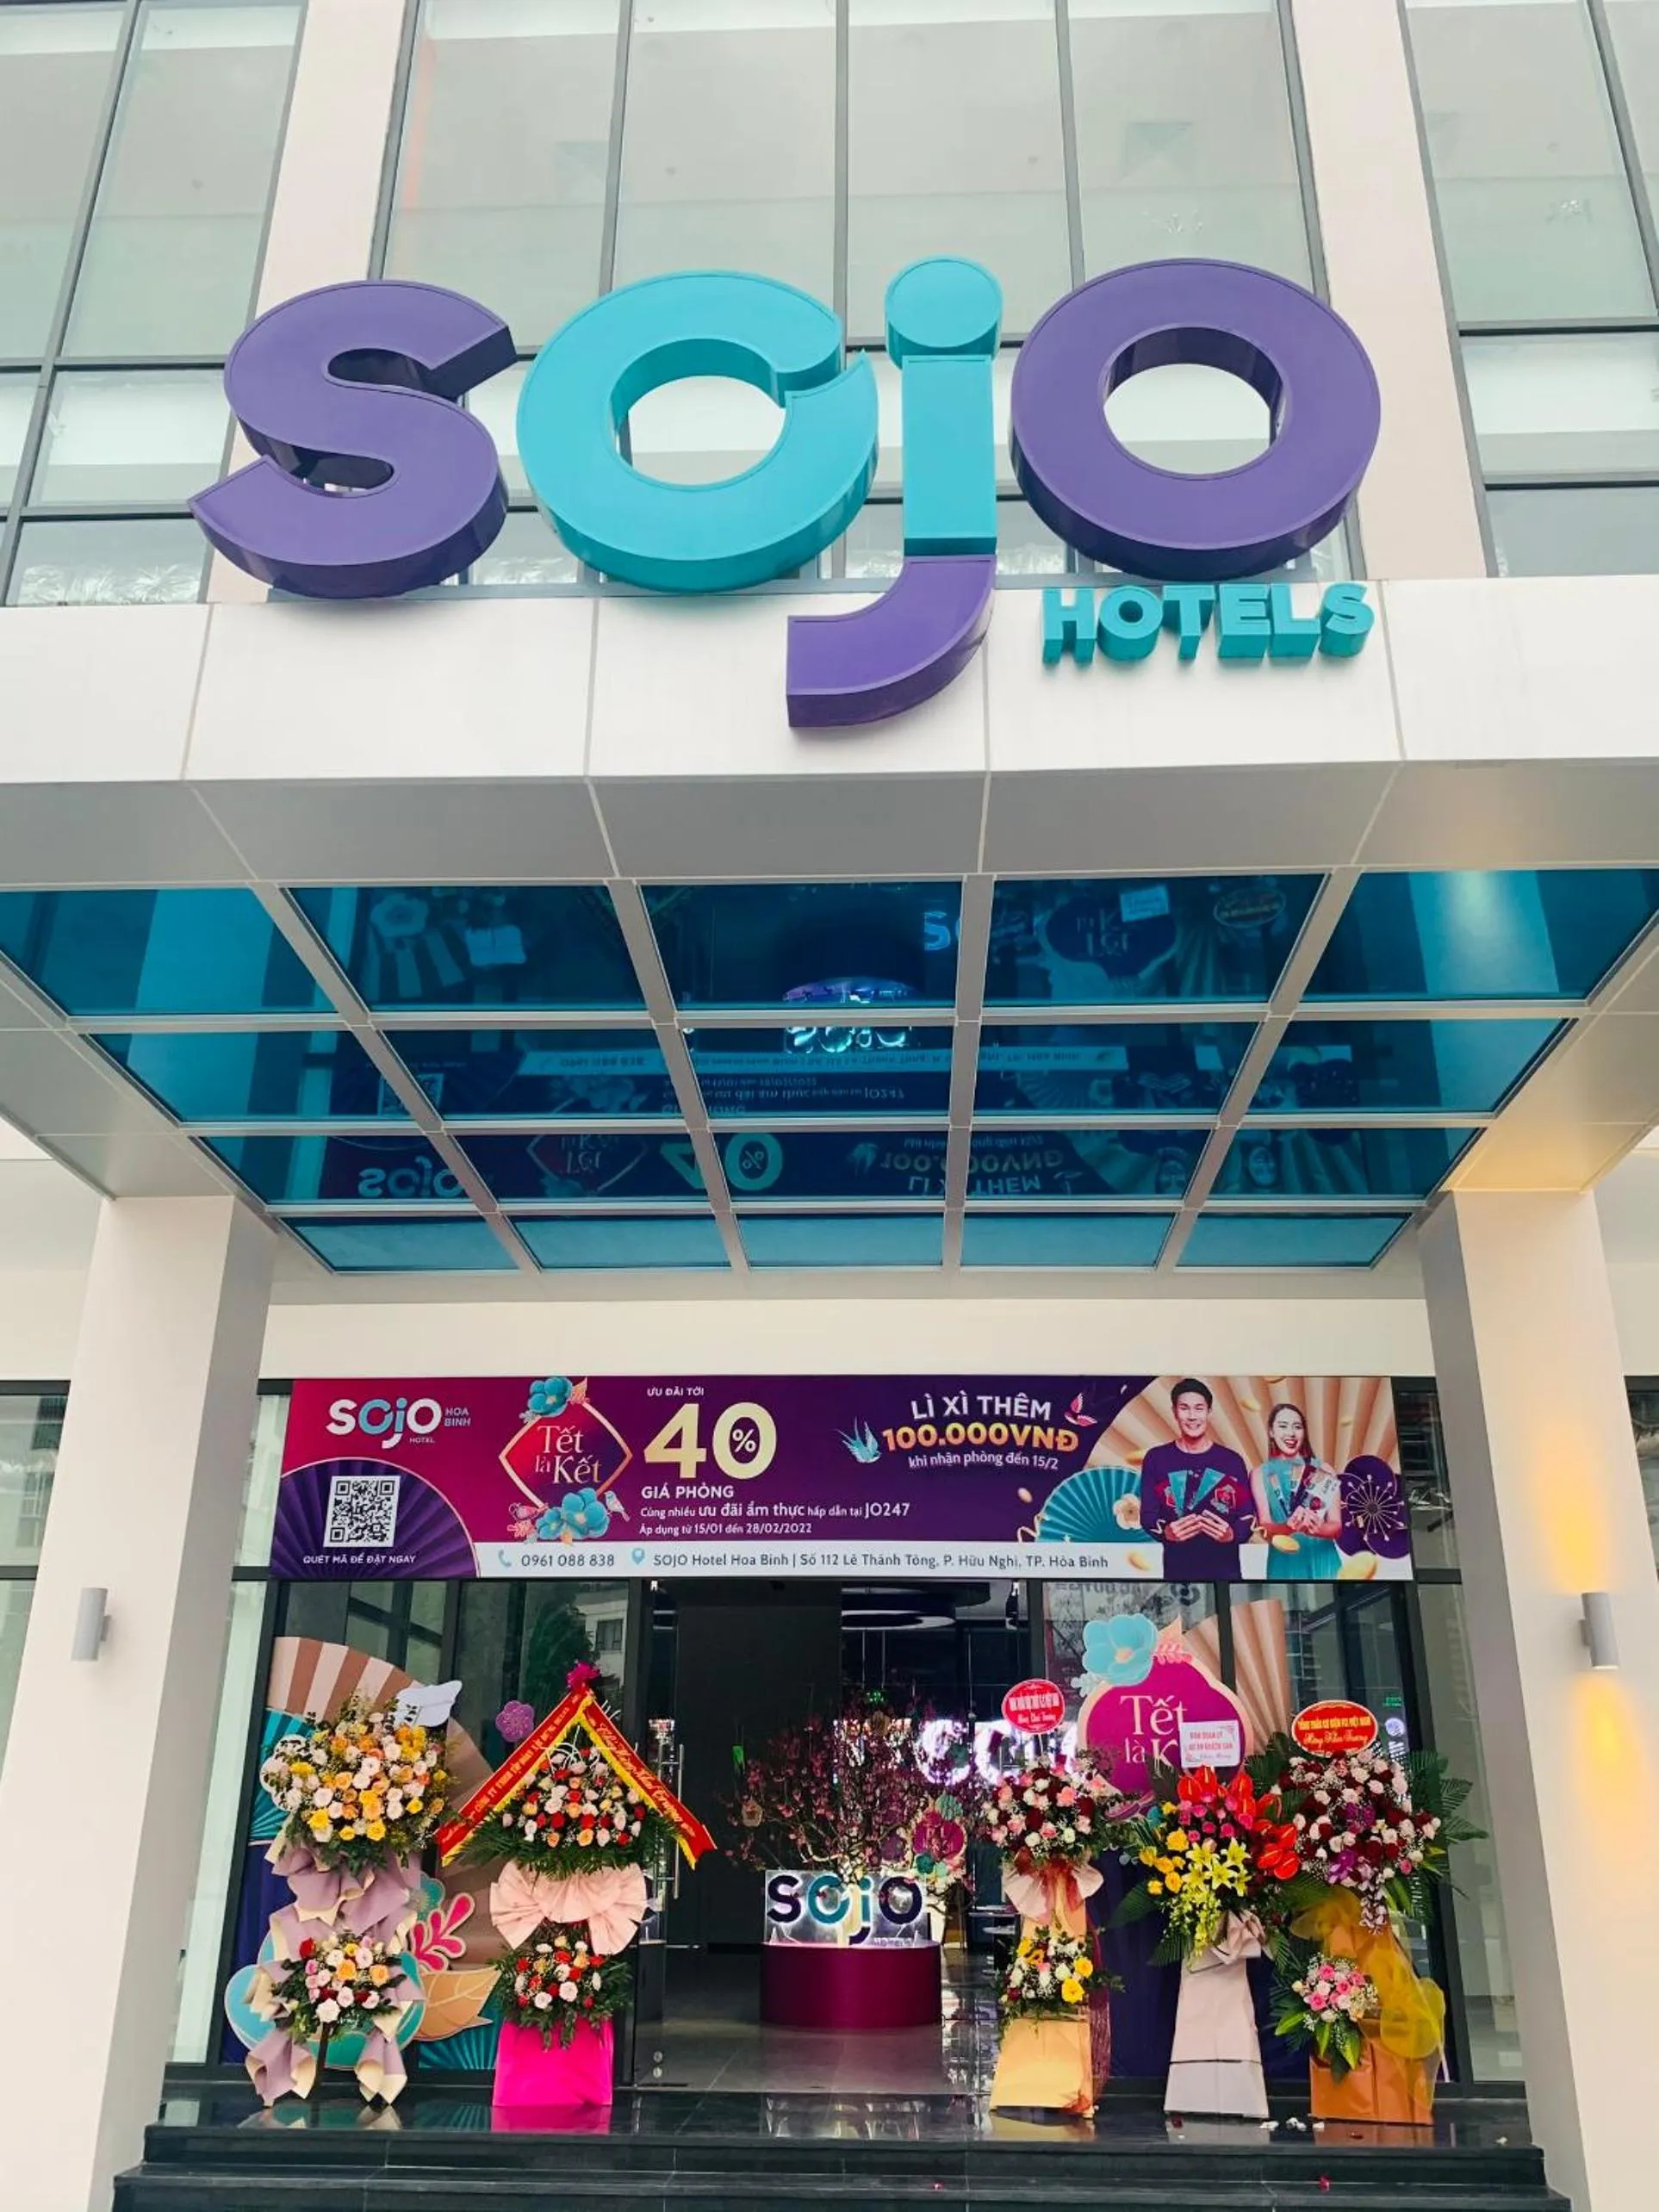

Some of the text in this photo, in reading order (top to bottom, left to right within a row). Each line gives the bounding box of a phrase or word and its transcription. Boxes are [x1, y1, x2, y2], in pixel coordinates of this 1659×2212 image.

[1042, 581, 1375, 664] HOTELS
[646, 1386, 704, 1397] ƯU ĐÃI TỚI
[444, 1407, 469, 1416] HOA
[910, 1389, 1052, 1420] LÌ XÌ THÊM
[537, 1425, 584, 1454] Tết
[643, 1401, 777, 1479] 40
[882, 1422, 1078, 1452] 100.000VNĐ
[552, 1454, 602, 1484] Kết
[908, 1450, 1059, 1470] khi nhận phòng đến 15/2
[641, 1484, 734, 1500] GIÁ PHÒNG
[698, 1504, 717, 1517] ưu
[720, 1502, 743, 1517] đãi
[774, 1502, 805, 1519] thực
[865, 1502, 910, 1519] JO247
[655, 1524, 679, 1536] dụng
[694, 1523, 723, 1535] 15/01
[746, 1523, 811, 1535] 28/02/2022
[388, 1555, 416, 1564] NGAY
[521, 1555, 614, 1567] 0961 088 838
[653, 1554, 688, 1569] SOJO
[693, 1554, 727, 1566] Hotel
[731, 1554, 756, 1566] Hoa
[799, 1553, 817, 1566] Số
[821, 1554, 839, 1566] 112
[843, 1553, 857, 1566] Lê
[943, 1555, 954, 1567] P.
[959, 1554, 985, 1567] Hữu
[1026, 1556, 1045, 1568] TP.
[1120, 1695, 1188, 1736] Tết
[1125, 1737, 1146, 1764] là
